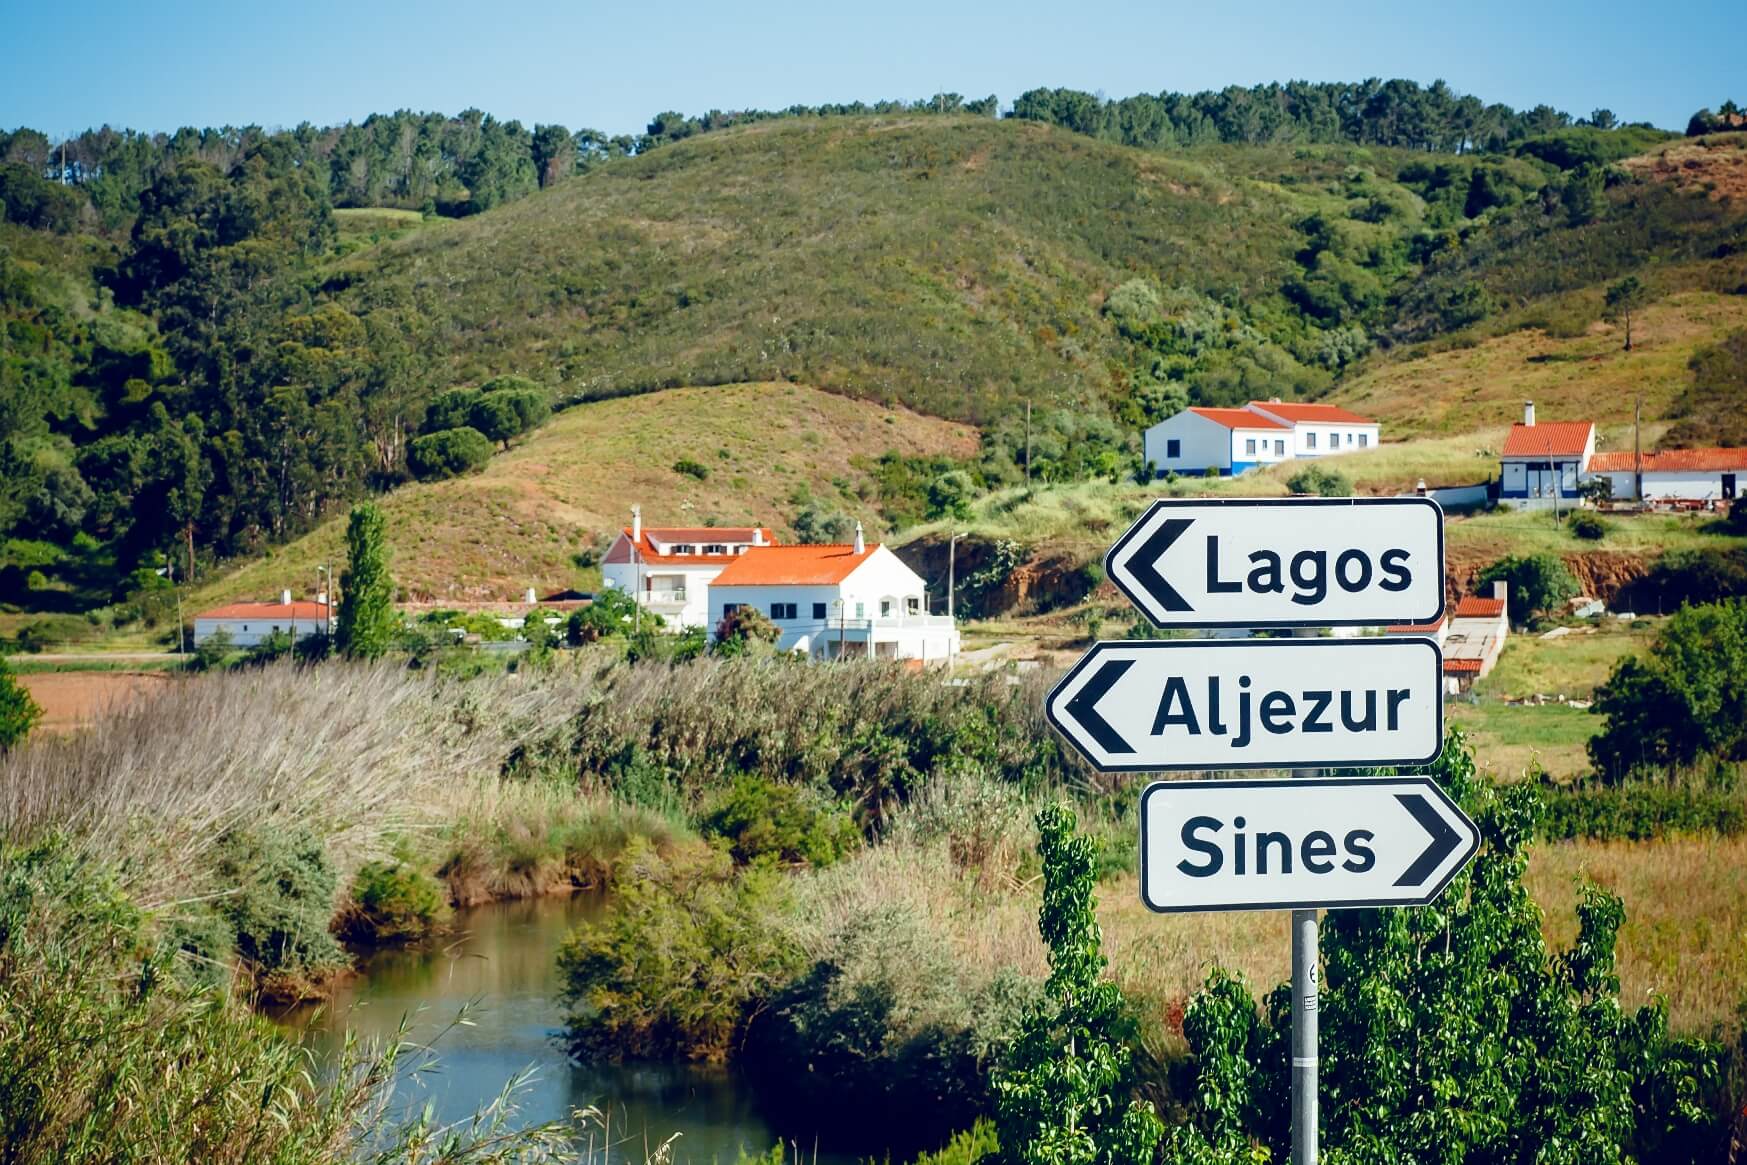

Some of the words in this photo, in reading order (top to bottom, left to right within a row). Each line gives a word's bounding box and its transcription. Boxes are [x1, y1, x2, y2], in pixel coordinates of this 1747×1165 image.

[1206, 535, 1413, 606] Lagos
[1149, 675, 1411, 748] Aljezur
[1176, 815, 1377, 878] Sines
